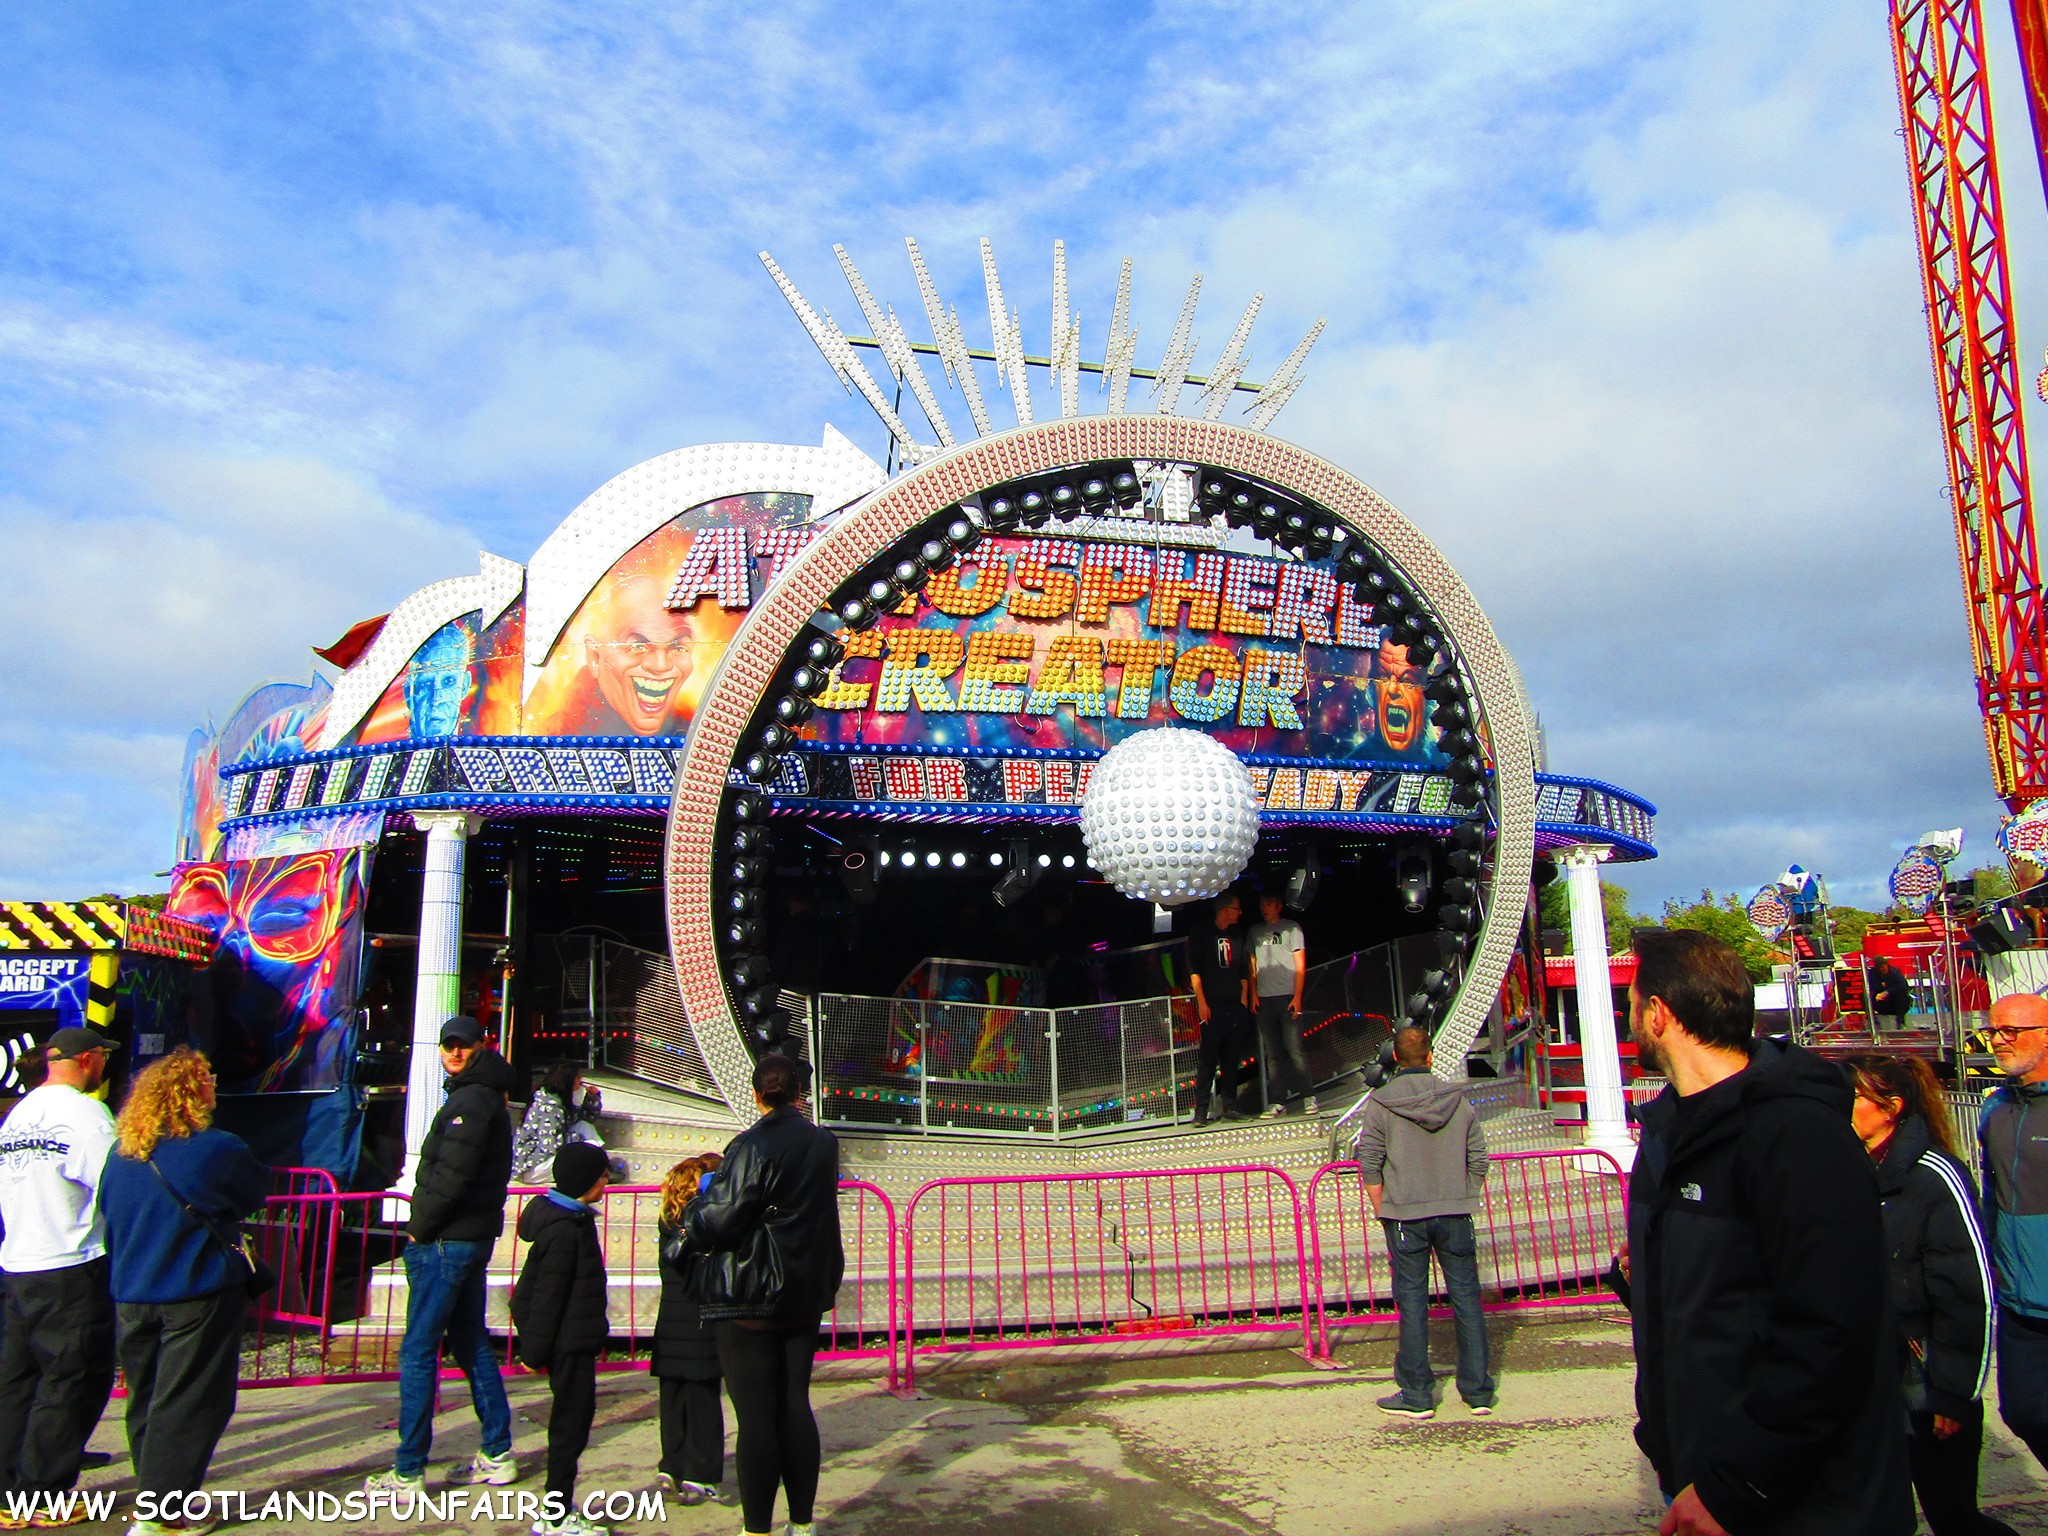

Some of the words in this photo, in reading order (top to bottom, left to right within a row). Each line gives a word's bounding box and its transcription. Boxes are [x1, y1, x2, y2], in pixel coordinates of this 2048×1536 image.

[663, 526, 1380, 650] ATOSPHERE
[808, 626, 1308, 731] CREATOR
[455, 748, 810, 797] PREPAD
[848, 756, 969, 801] FOR
[1248, 768, 1372, 811] EADY
[1393, 774, 1477, 816] FO
[0, 959, 79, 976] ACCEPT
